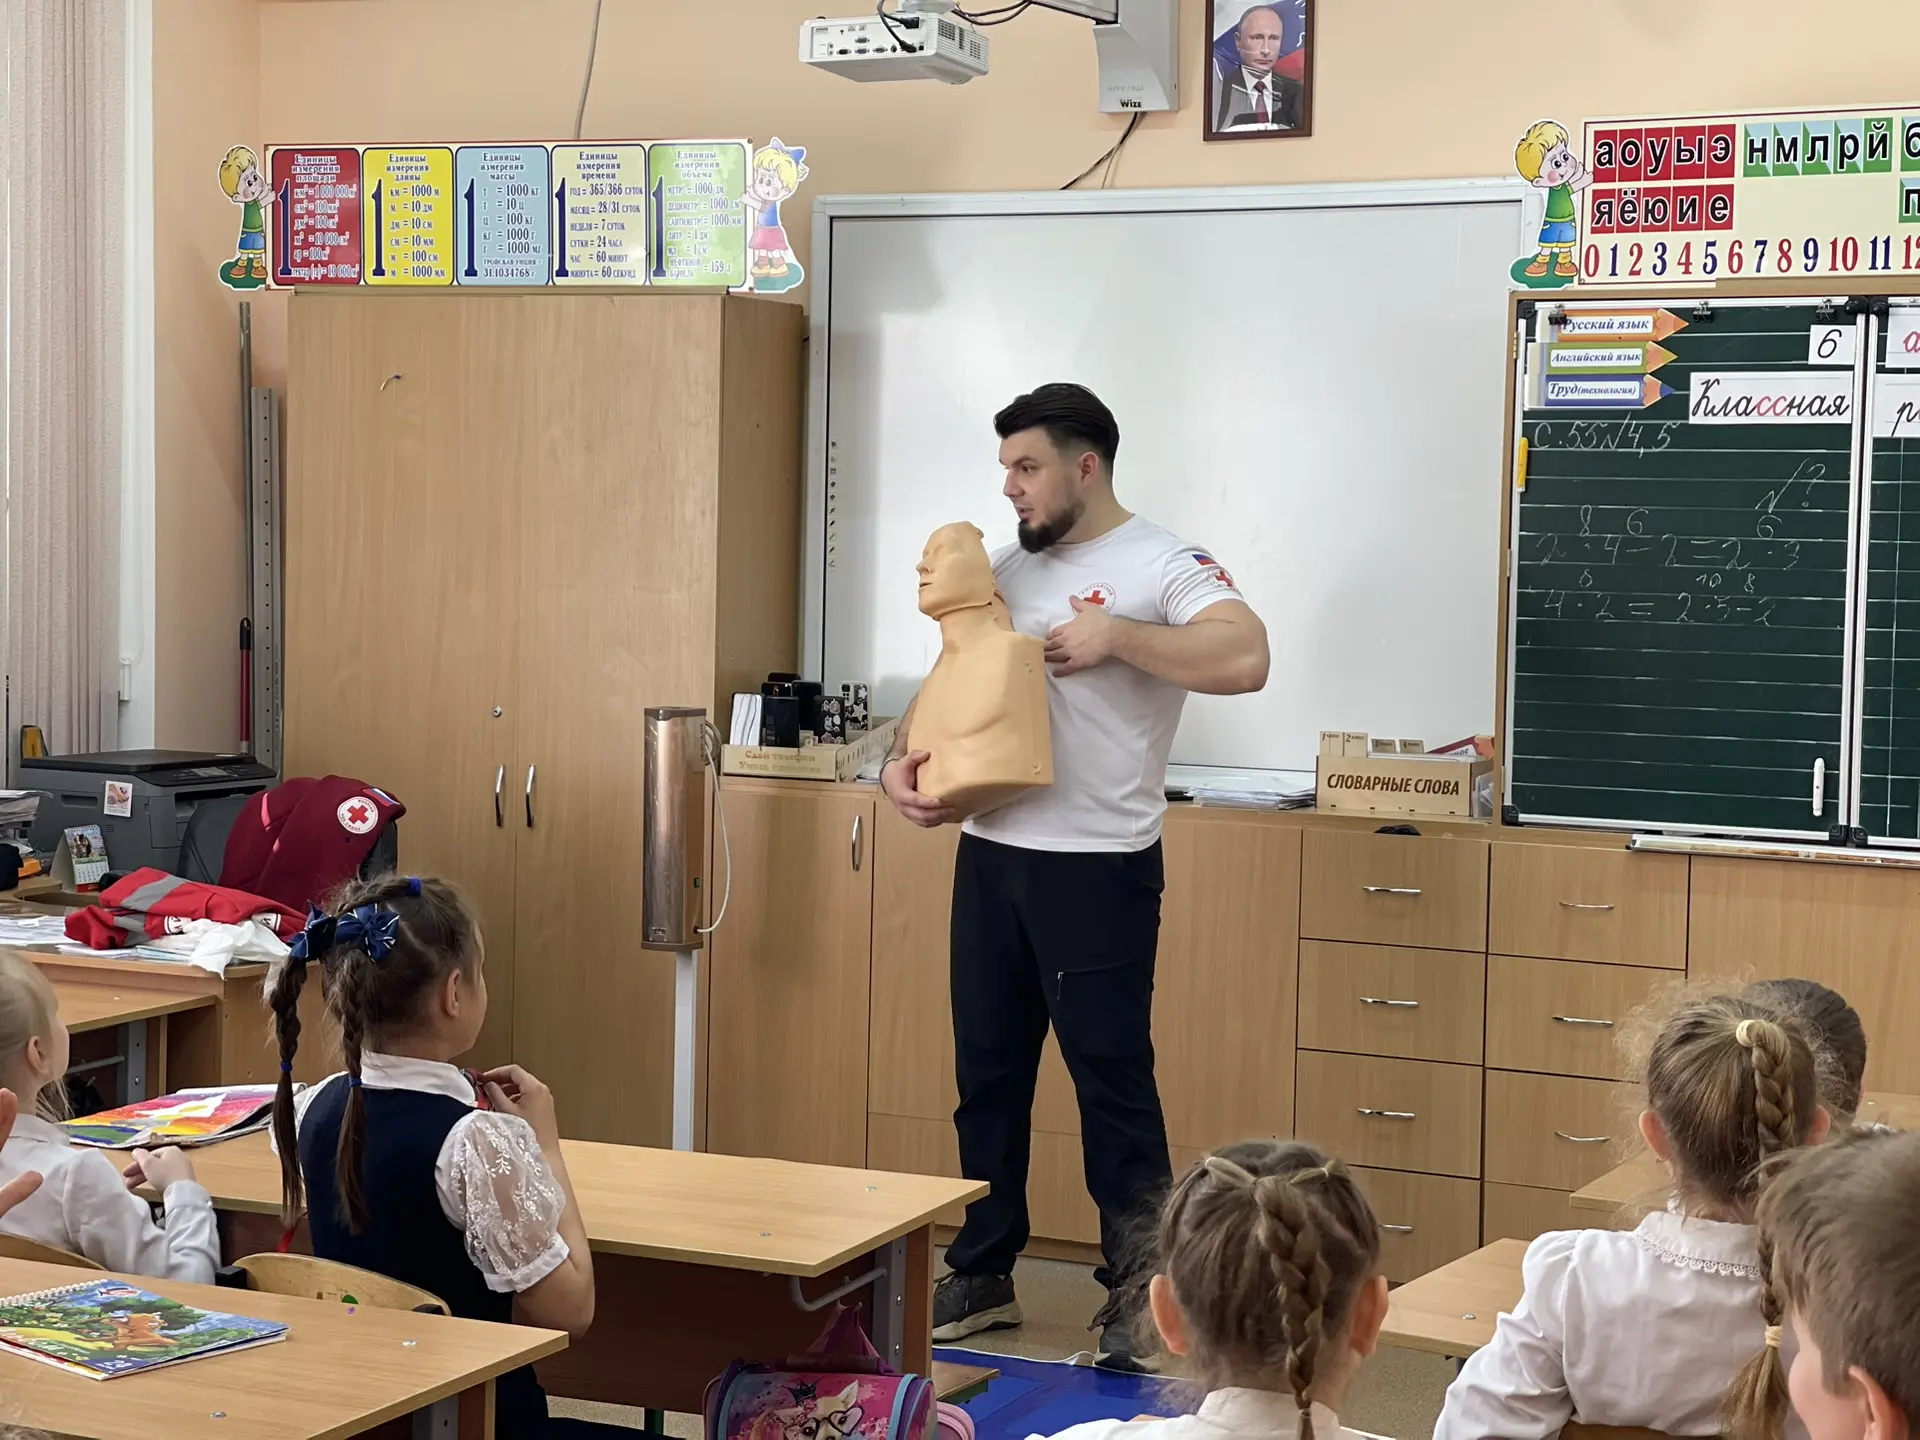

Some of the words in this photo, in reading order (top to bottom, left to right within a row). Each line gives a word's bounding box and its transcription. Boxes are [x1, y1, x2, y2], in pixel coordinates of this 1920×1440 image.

[295, 154, 337, 165] Единицы
[389, 153, 426, 164] Единицы
[483, 153, 521, 162] Единицы
[579, 151, 618, 161] Единицы
[677, 150, 717, 160] Единицы
[292, 165, 340, 174] измерения
[386, 165, 429, 174] измерения
[480, 164, 524, 173] измерения
[576, 163, 621, 172] измерения
[674, 162, 720, 171] измерения
[296, 175, 336, 183] площади
[394, 174, 421, 182] длины
[490, 173, 515, 181] массы
[581, 172, 616, 182] времени
[411, 185, 432, 197] 1000
[506, 184, 529, 197] 1000
[589, 183, 622, 196] 365/366
[694, 182, 713, 194] 1000
[411, 200, 420, 212] 10
[506, 198, 516, 210] 10
[598, 201, 620, 214] 28/31
[710, 198, 729, 209] 1000
[411, 217, 420, 229] 10
[507, 213, 523, 225] 100
[601, 219, 606, 231] 7
[711, 214, 729, 226] 1000
[507, 228, 529, 240] 1000
[412, 235, 420, 246] 10
[597, 236, 607, 248] 24
[507, 242, 530, 254] 1000
[412, 250, 427, 262] 100
[596, 251, 607, 263] 60
[1584, 244, 1600, 277] 0
[1609, 243, 1619, 276] 1
[1628, 242, 1644, 276] 2
[1652, 241, 1668, 276] 3
[1677, 241, 1693, 275] 4
[1702, 240, 1718, 275] 5
[1727, 239, 1743, 274] 6
[1754, 239, 1768, 273] 7
[1777, 238, 1792, 273] 8
[1803, 237, 1819, 272] 9
[1829, 236, 1859, 271] 10
[1868, 235, 1892, 270] 11
[412, 266, 433, 277] 1000
[601, 266, 612, 278] 60
[711, 261, 724, 273] 159
[1563, 318, 1614, 332] Русский
[1617, 319, 1649, 330] язык
[1817, 328, 1842, 359] 6
[1552, 352, 1613, 363] Английский
[1615, 352, 1641, 362] язык
[1691, 378, 1850, 418] Классная
[1627, 508, 1649, 537] 6
[1757, 514, 1782, 540] 6
[1327, 773, 1413, 793] СЛОВАРНЫЕ
[1414, 778, 1460, 796] СЛОВА
